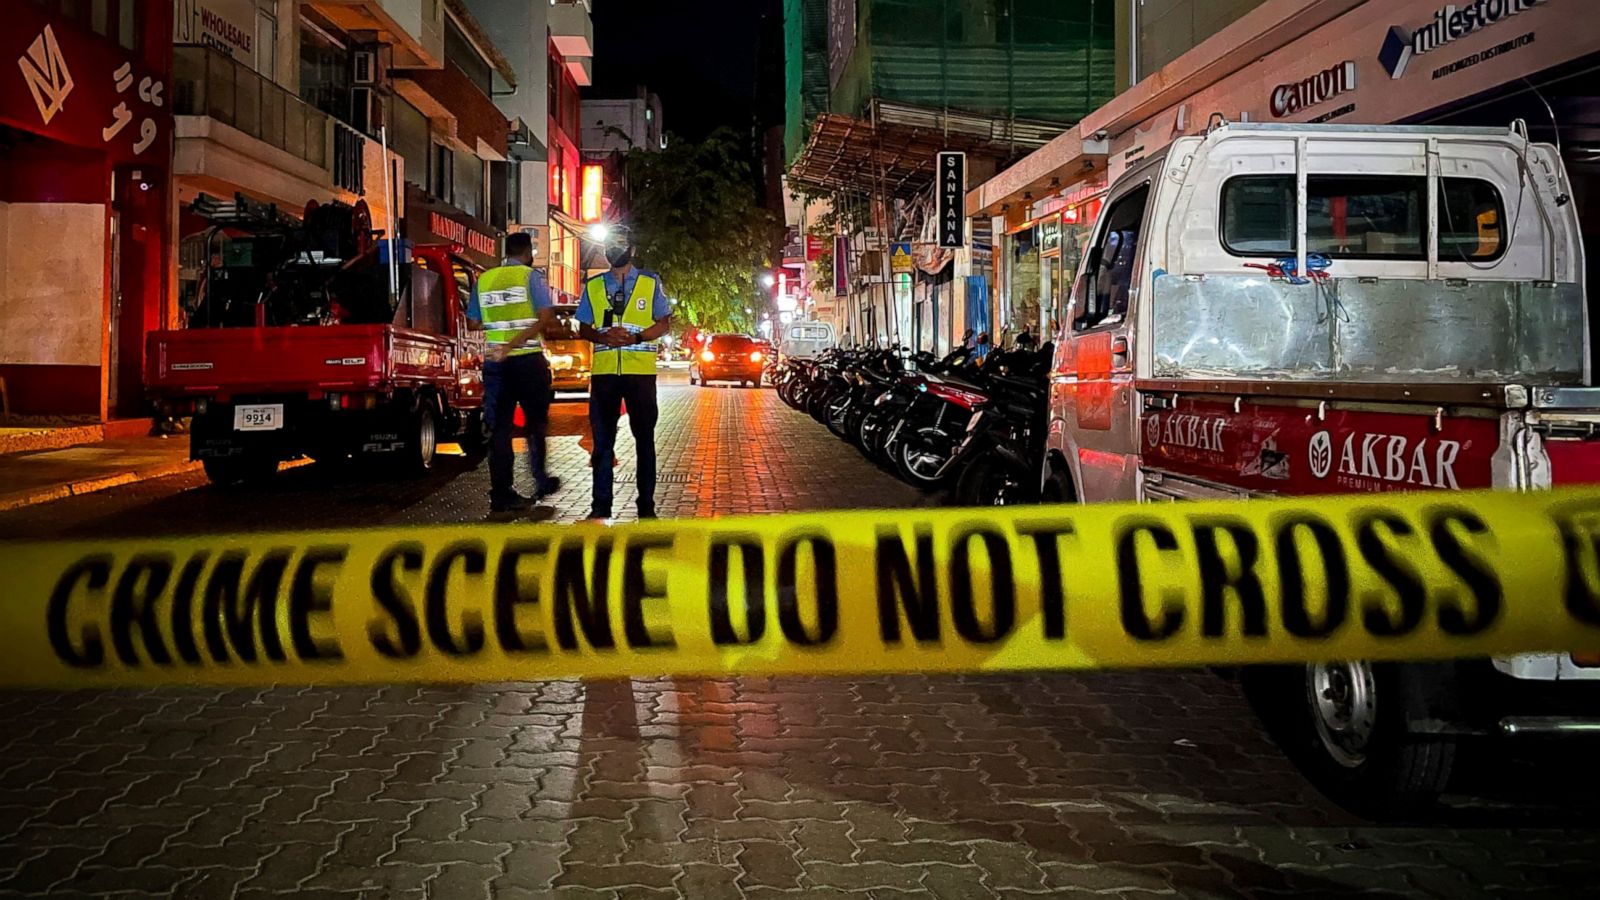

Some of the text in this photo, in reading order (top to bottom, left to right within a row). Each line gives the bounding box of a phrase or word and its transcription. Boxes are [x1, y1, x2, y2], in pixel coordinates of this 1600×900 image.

[201, 6, 251, 54] WHOLESALE
[1411, 0, 1544, 54] mileston
[1432, 32, 1535, 80] AUTHORIZED DISTRIBUTOR
[1270, 60, 1355, 118] Canon
[946, 156, 956, 244] SANTANA
[431, 211, 497, 258] MANDHU COLLEGE
[246, 413, 272, 422] 9914
[1163, 413, 1225, 452] AKBAR
[1337, 475, 1381, 492] PREMIUM
[1338, 431, 1462, 491] AKBAR
[46, 539, 349, 670] CRIME
[368, 530, 679, 660] SCENE
[707, 532, 839, 647] DO
[875, 516, 1076, 648] NOT
[1113, 506, 1505, 642] CROSS
